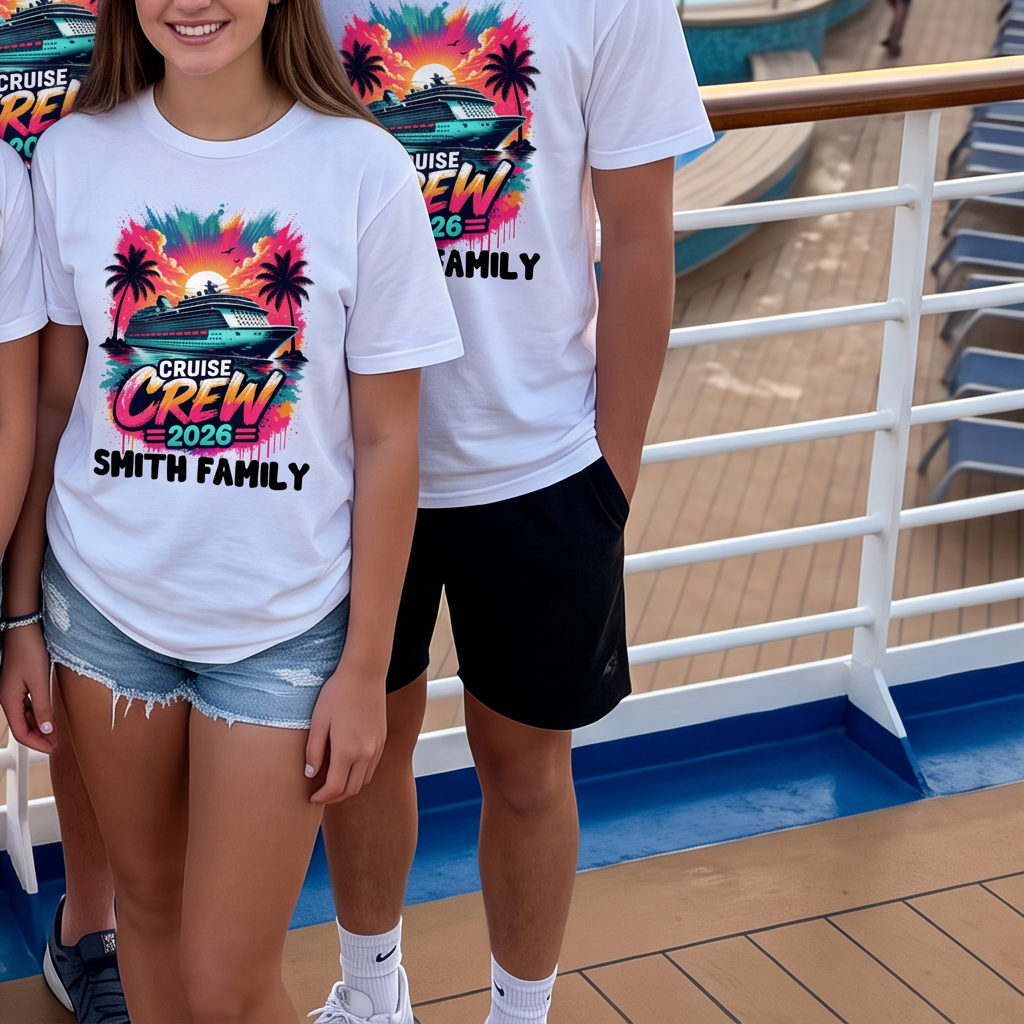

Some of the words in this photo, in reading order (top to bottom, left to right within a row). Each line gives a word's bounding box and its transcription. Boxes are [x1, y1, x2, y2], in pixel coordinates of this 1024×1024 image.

[409, 151, 460, 170] UISE
[417, 160, 512, 217] EW
[429, 214, 463, 238] 26
[159, 359, 232, 378] CRUISE
[115, 365, 284, 428] CREW
[167, 423, 233, 447] 2026
[93, 448, 187, 482] SMITH
[196, 456, 310, 491] FAMILY
